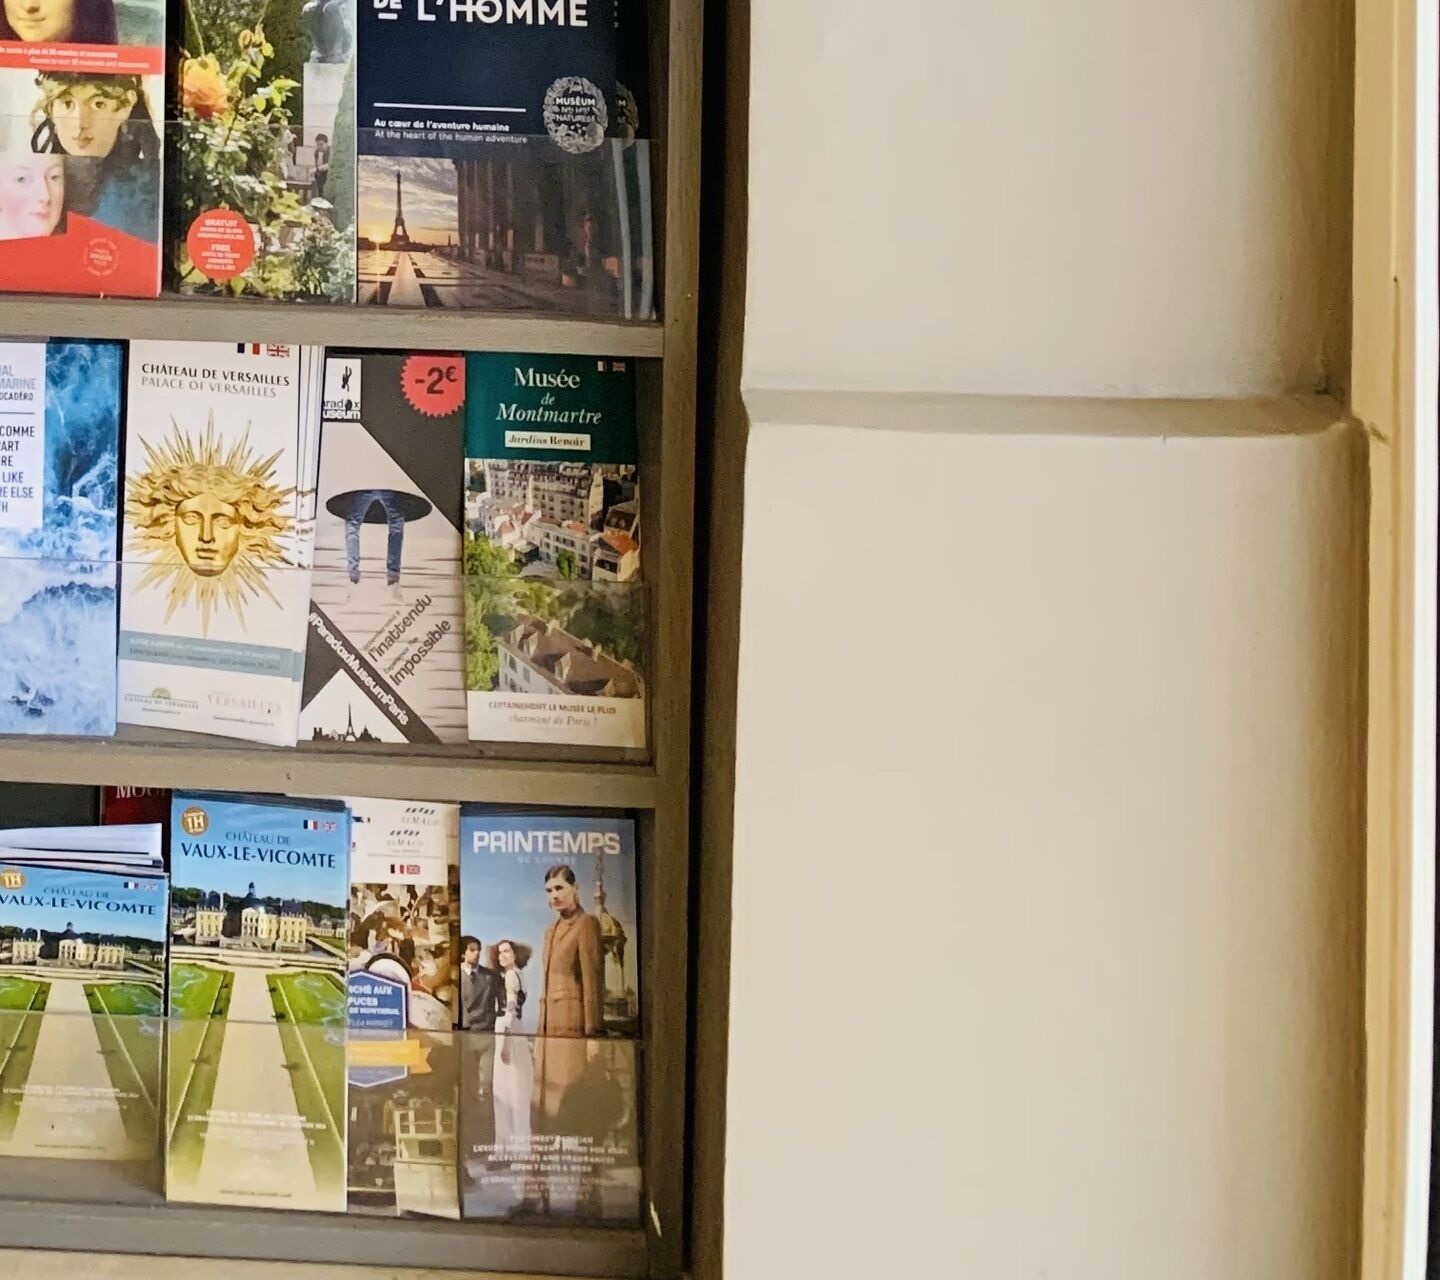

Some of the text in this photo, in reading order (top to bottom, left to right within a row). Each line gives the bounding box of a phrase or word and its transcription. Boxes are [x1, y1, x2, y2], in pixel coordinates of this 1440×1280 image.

[141, 362, 290, 386] CHÂTEAU DE VERSAILLES
[414, 365, 458, 395] -2€
[514, 367, 581, 389] Musée
[540, 392, 555, 405] de
[496, 402, 602, 425] Montmartre
[1, 471, 24, 483] LIKE
[10, 486, 34, 499] ELSE
[368, 594, 432, 662] l'inattendu
[389, 620, 452, 686] Impossible
[224, 830, 291, 846] CHÂTEAU DE
[472, 829, 621, 856] PRINTEMPS
[180, 842, 338, 870] VAUX-LE-VICOMTE
